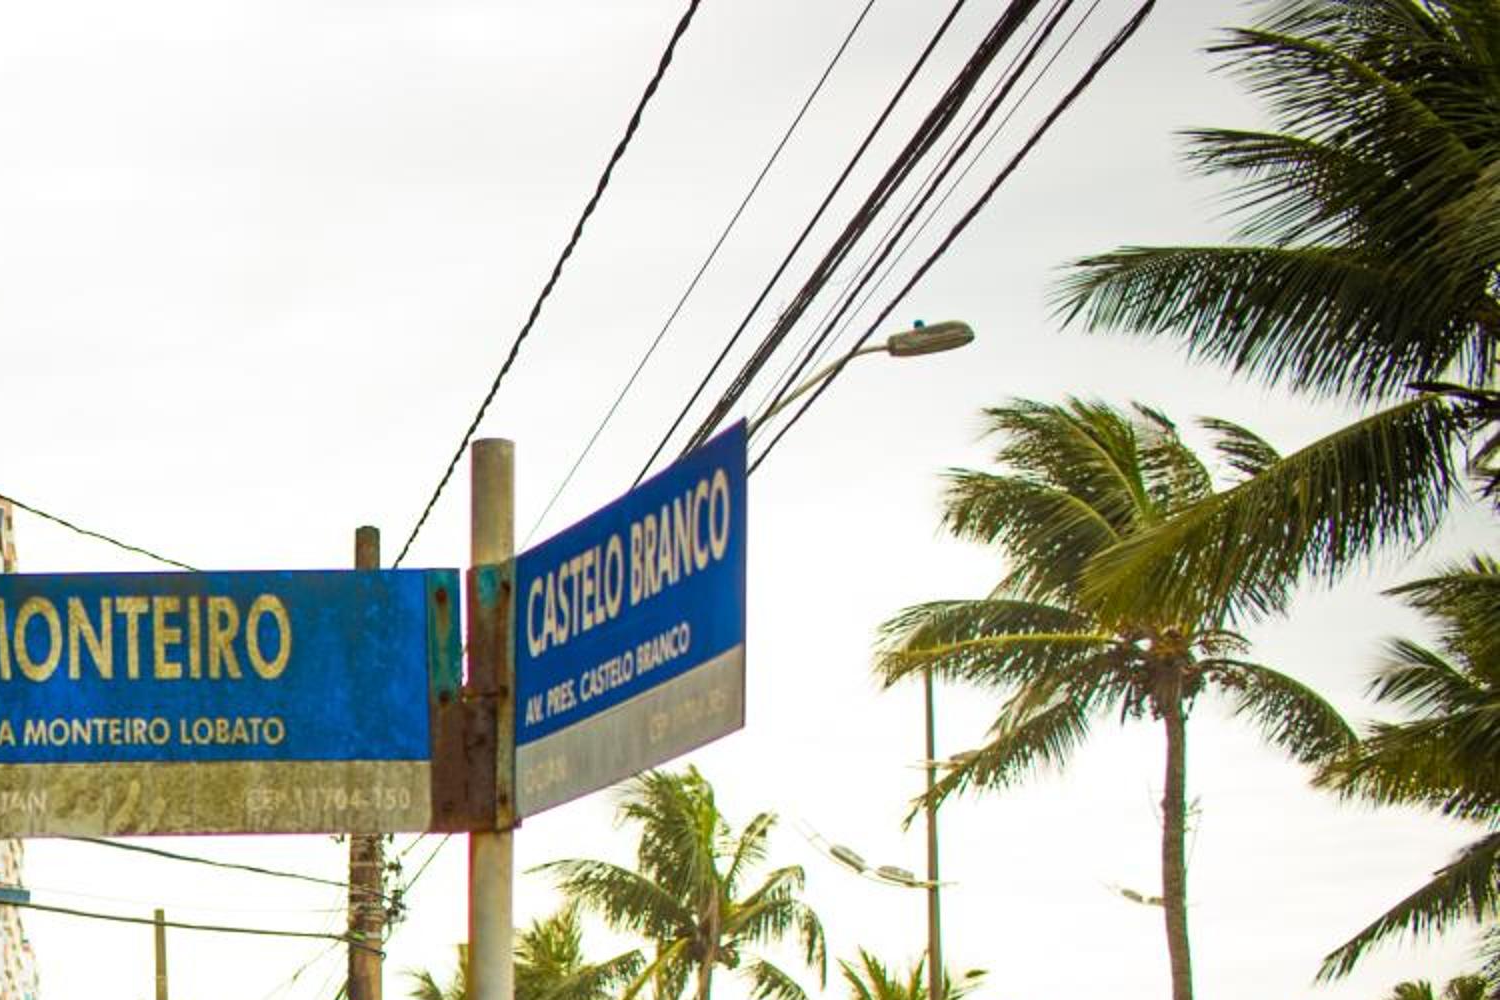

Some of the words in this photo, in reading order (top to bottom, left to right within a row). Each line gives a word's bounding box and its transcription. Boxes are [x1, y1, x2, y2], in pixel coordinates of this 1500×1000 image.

[526, 533, 624, 658] CASTELO
[630, 468, 730, 606] BRANCO
[524, 692, 544, 728] AV.
[546, 679, 577, 716] PRES.
[579, 650, 634, 702] CASTELO
[636, 621, 691, 676] BRANCO
[22, 717, 172, 746] MONTEIRO
[179, 716, 286, 745] LOBATO
